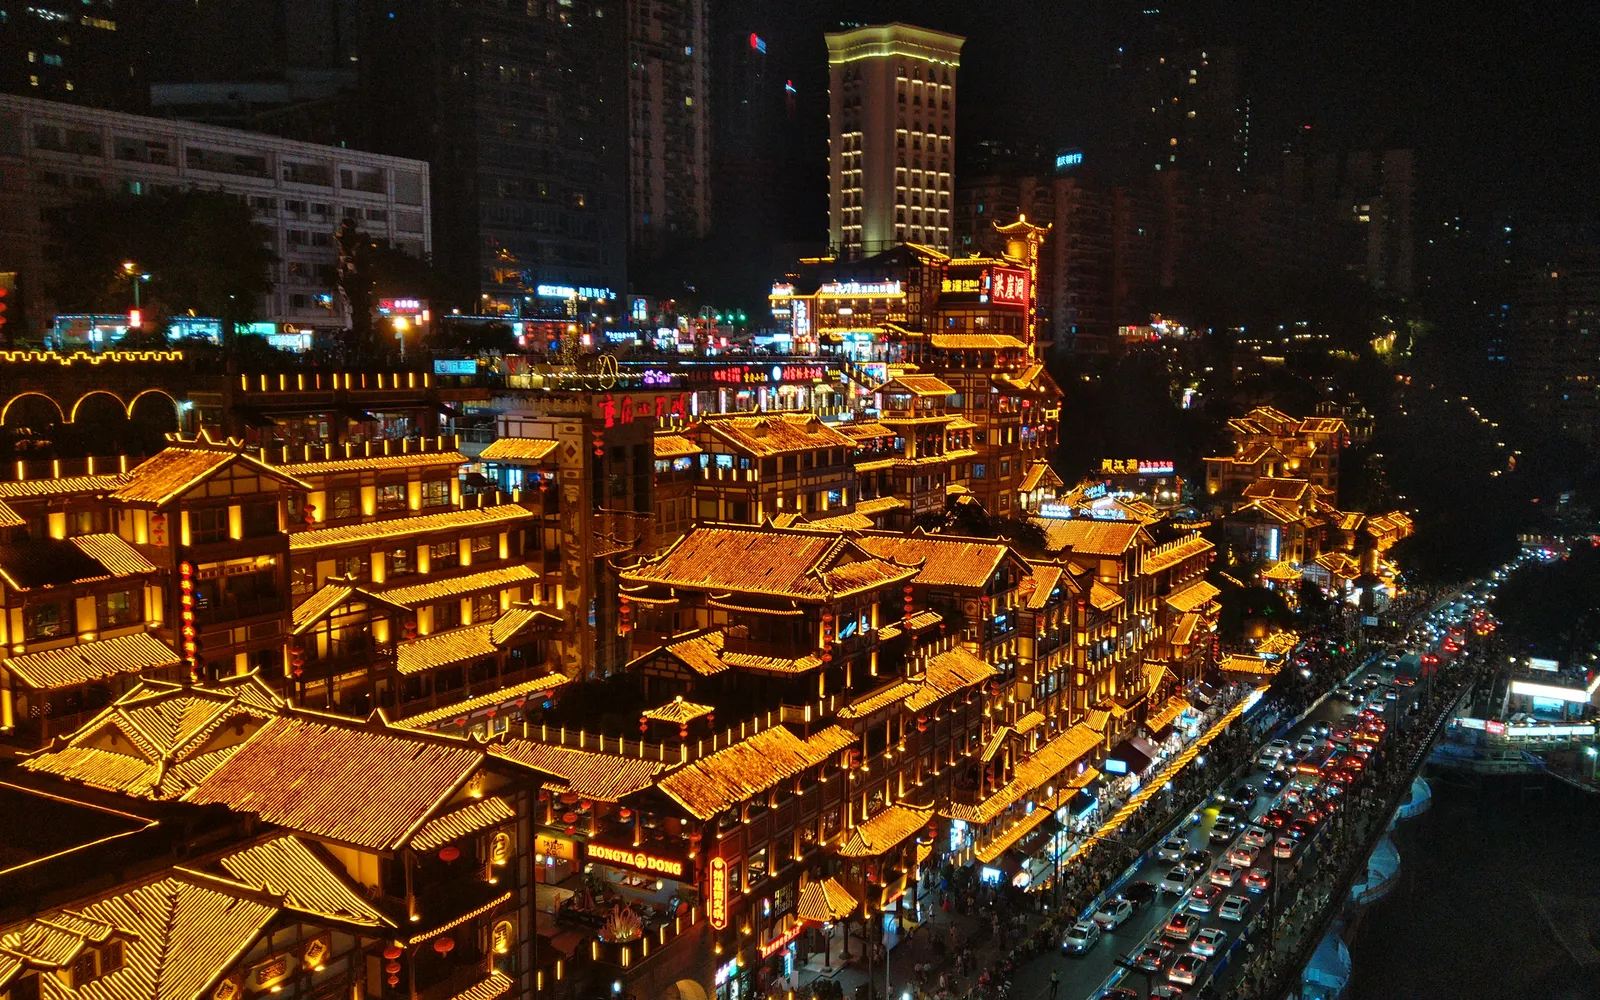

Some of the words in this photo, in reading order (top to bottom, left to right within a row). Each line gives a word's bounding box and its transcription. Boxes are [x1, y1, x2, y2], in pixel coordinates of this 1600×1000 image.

[994, 273, 1025, 300] 洪崖洞
[588, 844, 635, 866] HONGYA
[647, 857, 682, 875] DONG
[713, 869, 724, 920] 洪崖洞火锅
